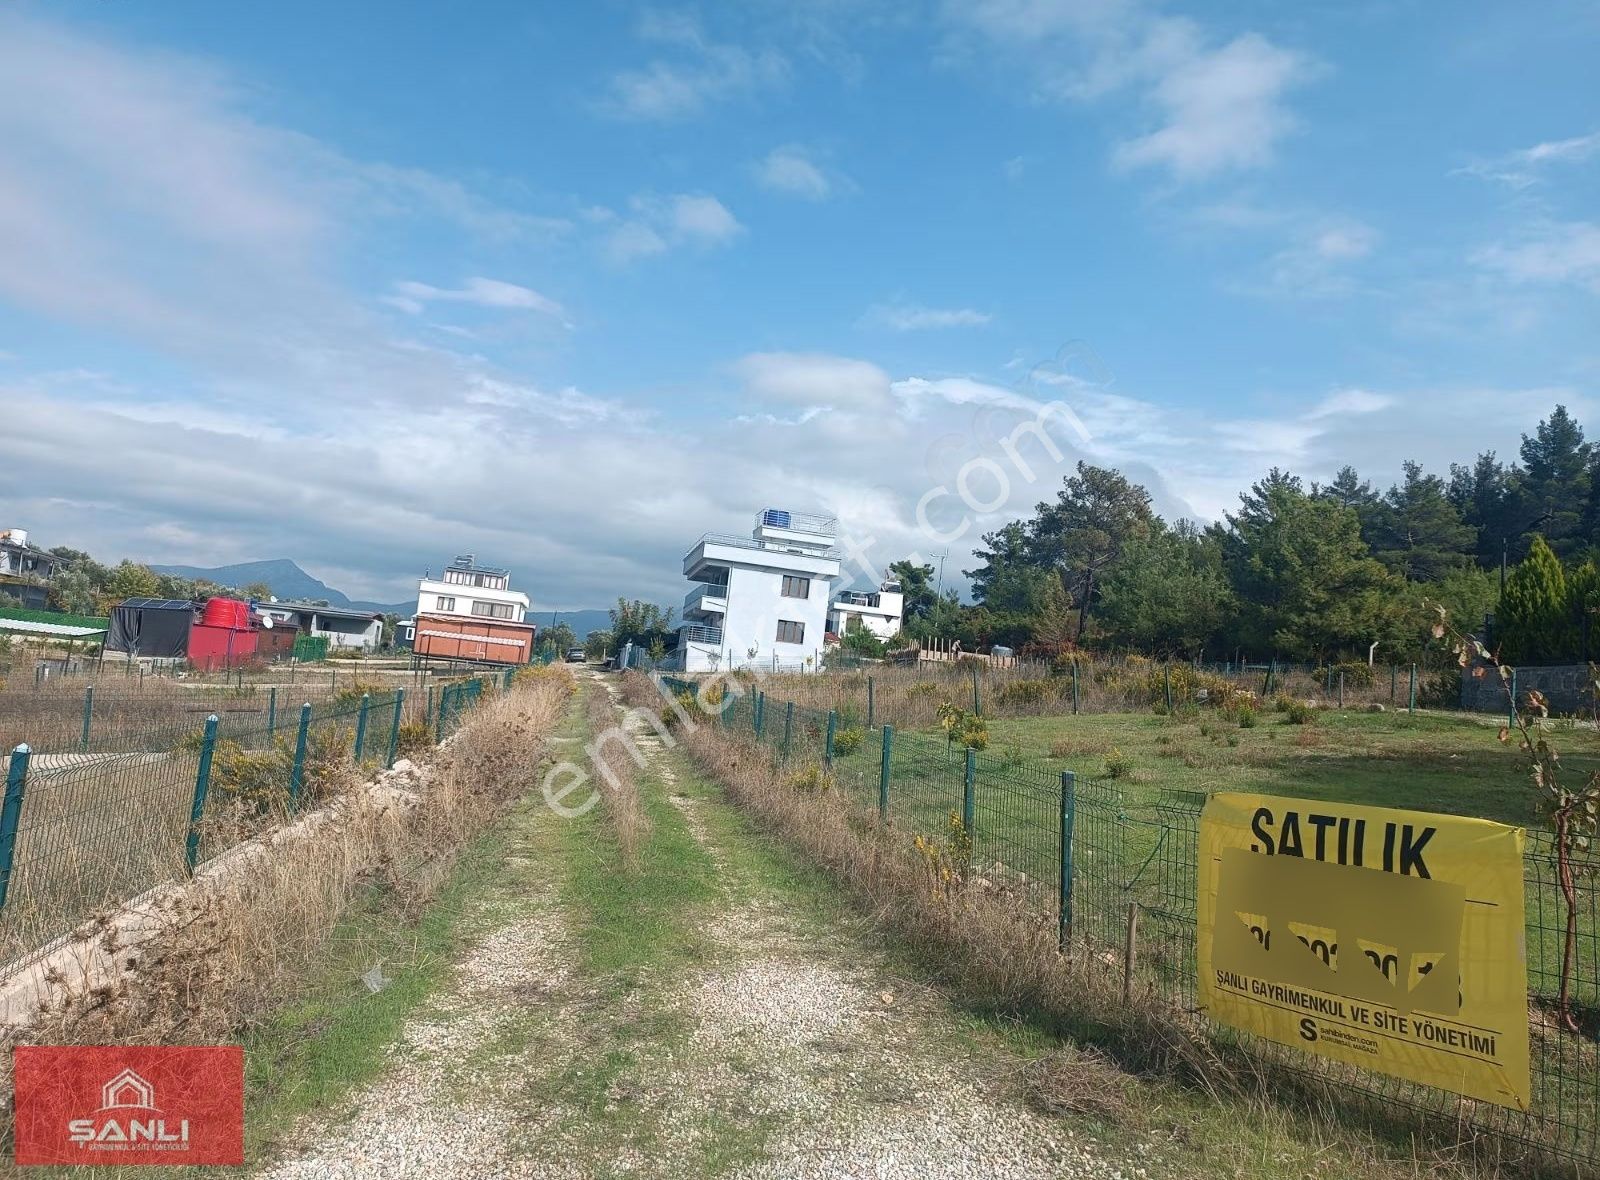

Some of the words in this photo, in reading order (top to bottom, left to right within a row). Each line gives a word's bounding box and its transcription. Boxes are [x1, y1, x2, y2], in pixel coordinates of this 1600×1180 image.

[1251, 979, 1347, 1019] GAYRİMENKUL
[1350, 1005, 1370, 1025] VE
[1373, 1010, 1409, 1034] SİTE
[1412, 1020, 1496, 1056] YÖNETİMİ
[1320, 1027, 1378, 1048] sahibinden.com
